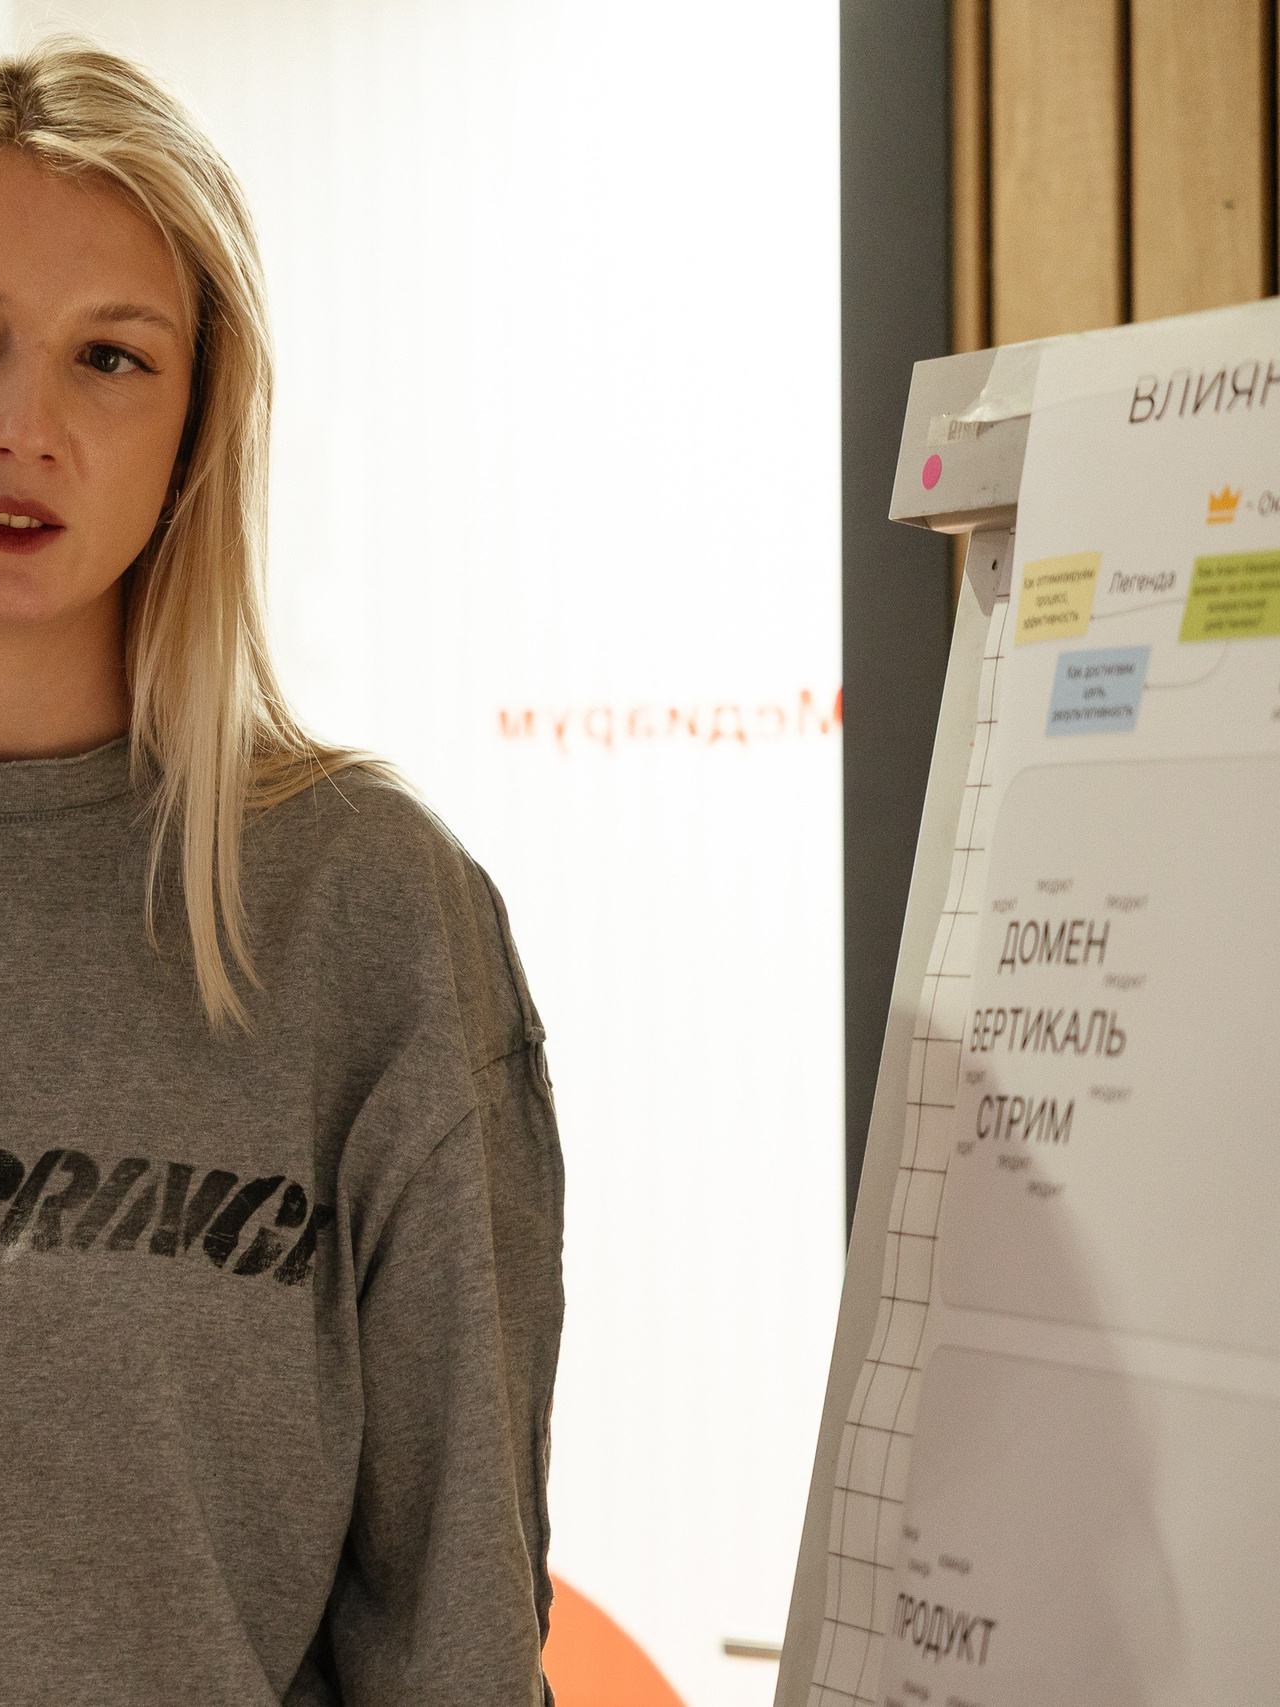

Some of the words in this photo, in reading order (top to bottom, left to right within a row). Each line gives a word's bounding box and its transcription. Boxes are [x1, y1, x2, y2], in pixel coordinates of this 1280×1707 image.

[1108, 569, 1177, 595] Легенда
[997, 919, 1110, 975] ДОМЕН
[970, 1007, 1127, 1058] ВЕРТИКАЛЬ
[976, 1094, 1074, 1144] СТРИМ
[892, 1592, 996, 1667] ПРОДУКТ
